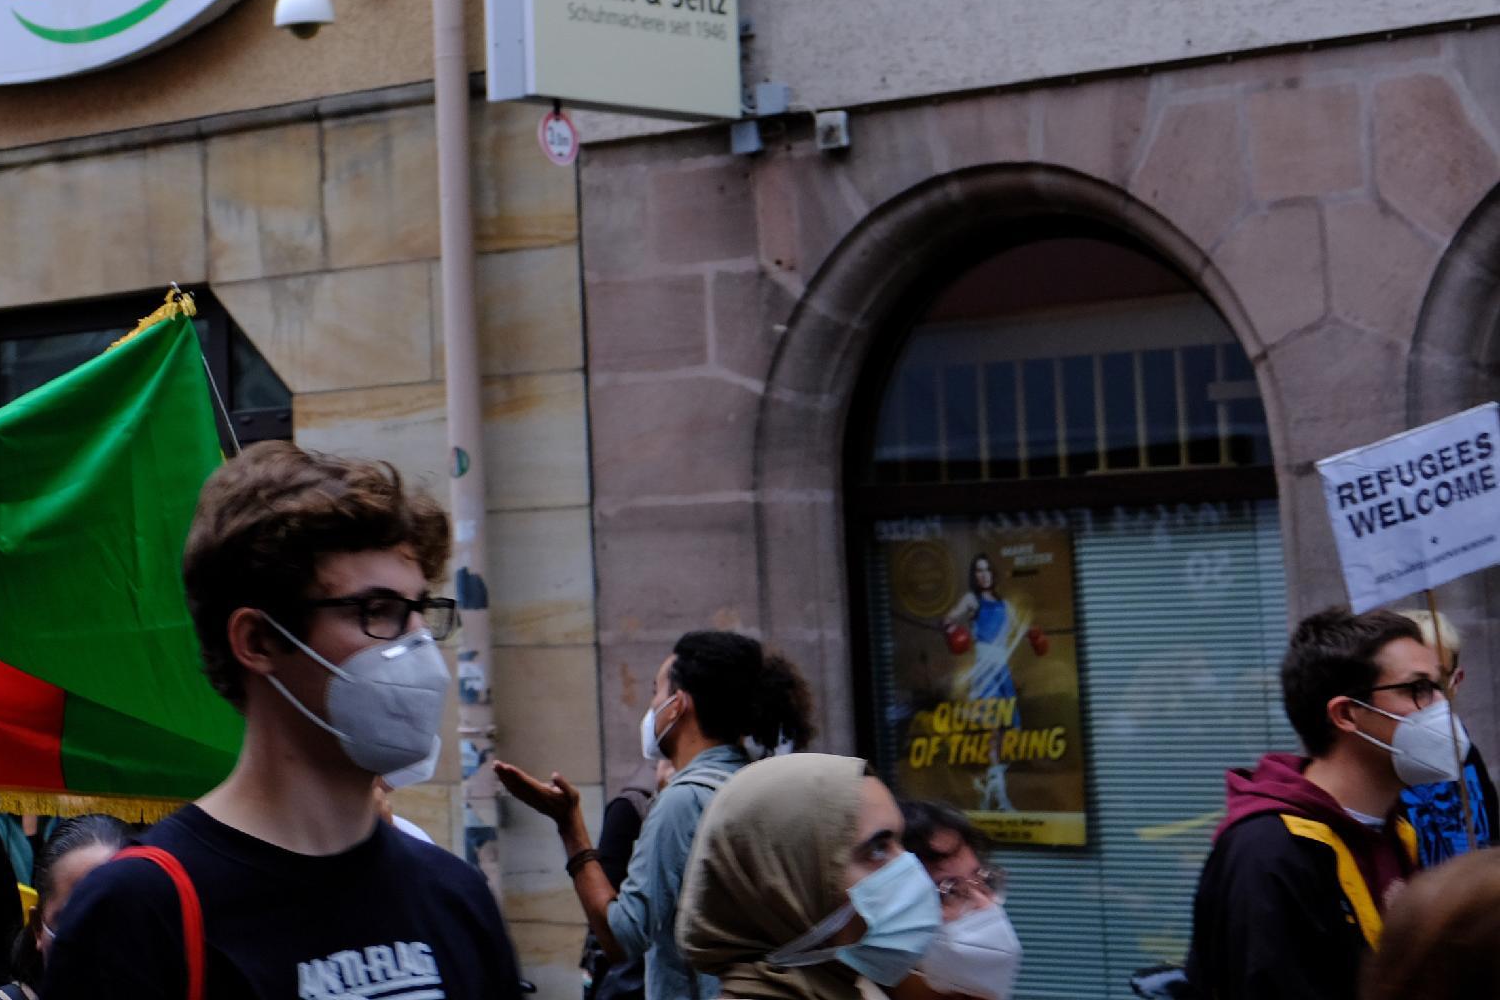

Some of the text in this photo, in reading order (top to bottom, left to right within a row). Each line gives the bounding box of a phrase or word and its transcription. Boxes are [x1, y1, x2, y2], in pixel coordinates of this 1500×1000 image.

[669, 18, 692, 37] seit
[1337, 431, 1495, 510] REFUGEES
[1347, 464, 1498, 539] WELCOME
[931, 695, 1018, 734] QUEEN
[908, 724, 1069, 771] OF THE RING
